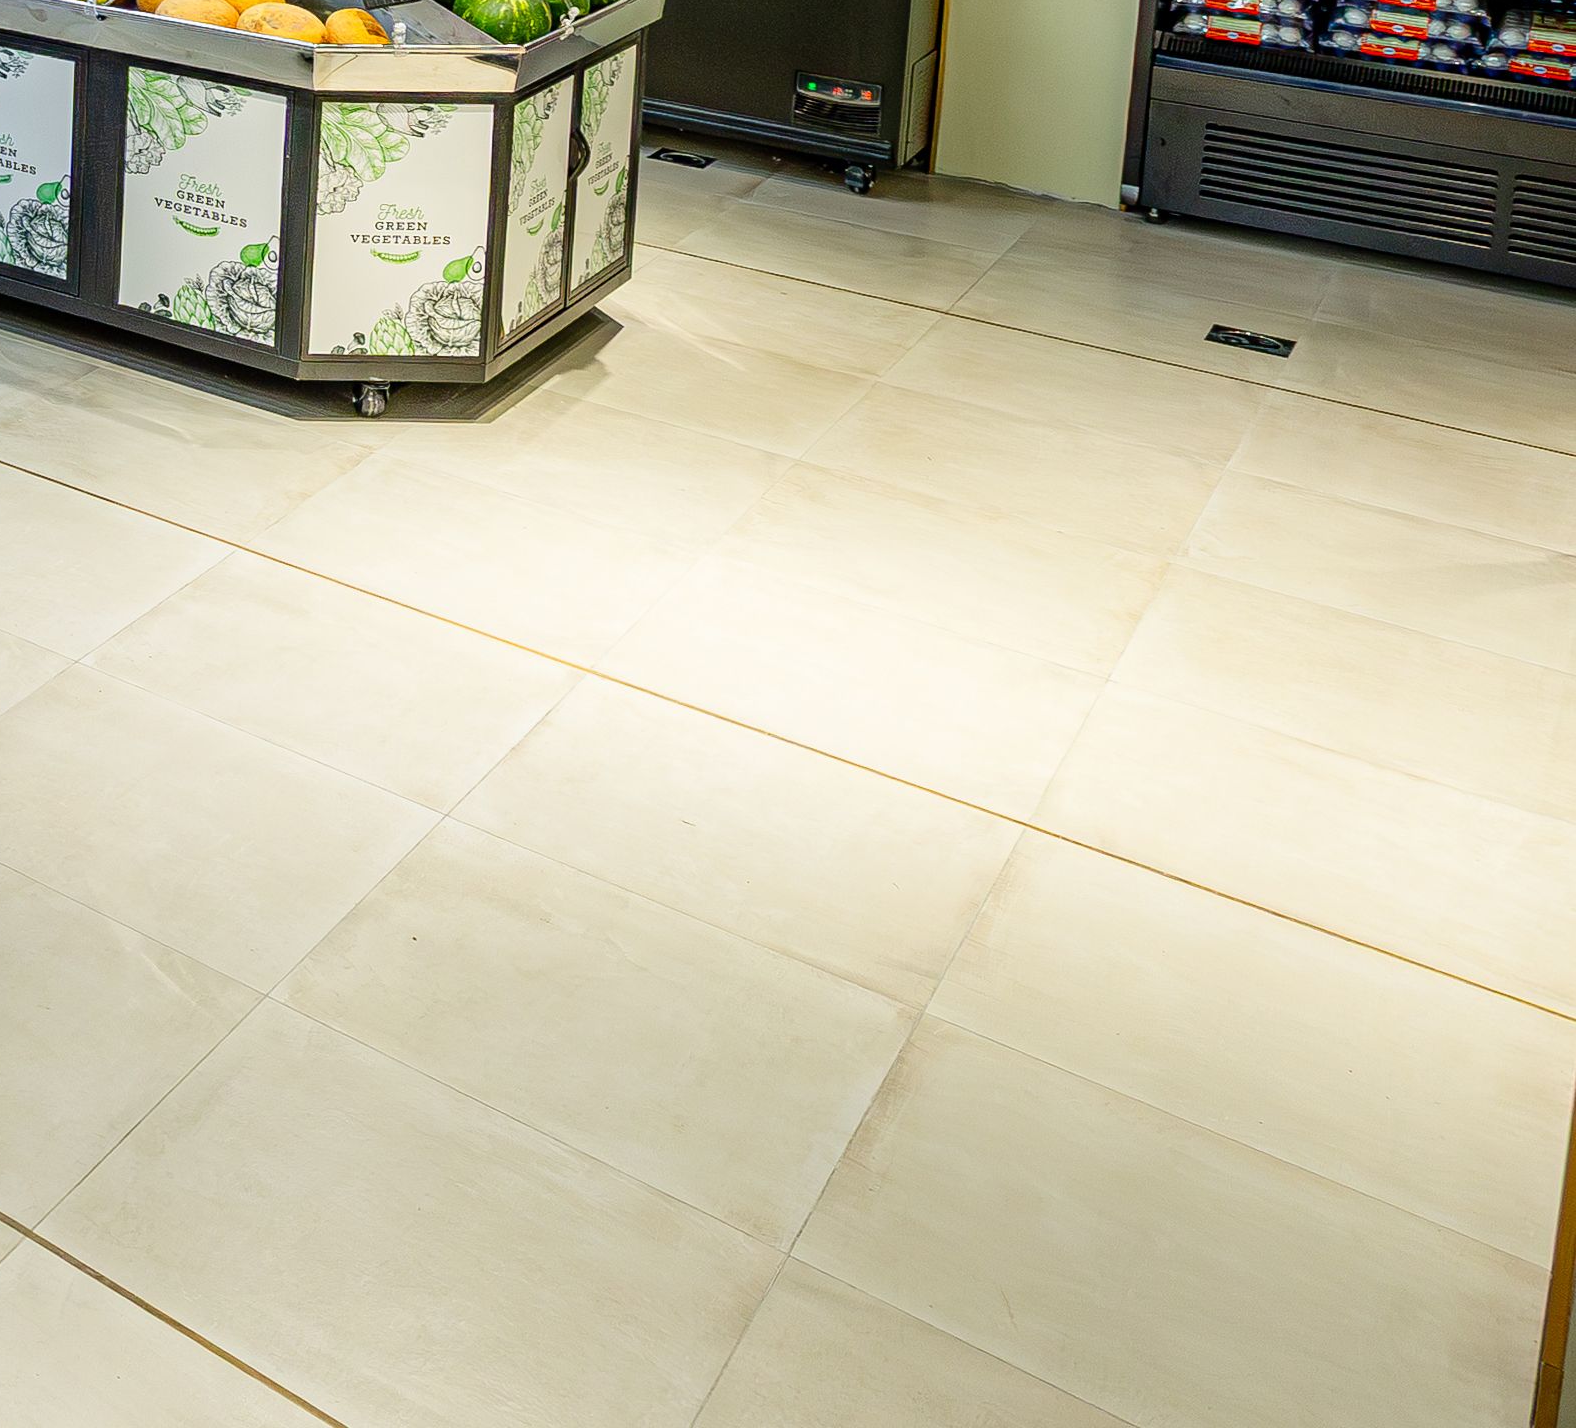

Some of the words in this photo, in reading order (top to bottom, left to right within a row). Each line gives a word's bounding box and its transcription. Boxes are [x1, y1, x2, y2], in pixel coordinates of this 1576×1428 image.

[178, 173, 222, 197] Fresh
[176, 189, 226, 209] GREEN
[154, 197, 248, 229] VEGETABLES
[377, 203, 425, 221] Fresh
[374, 221, 428, 232] GREEN
[350, 233, 452, 246] VEGETABLES
